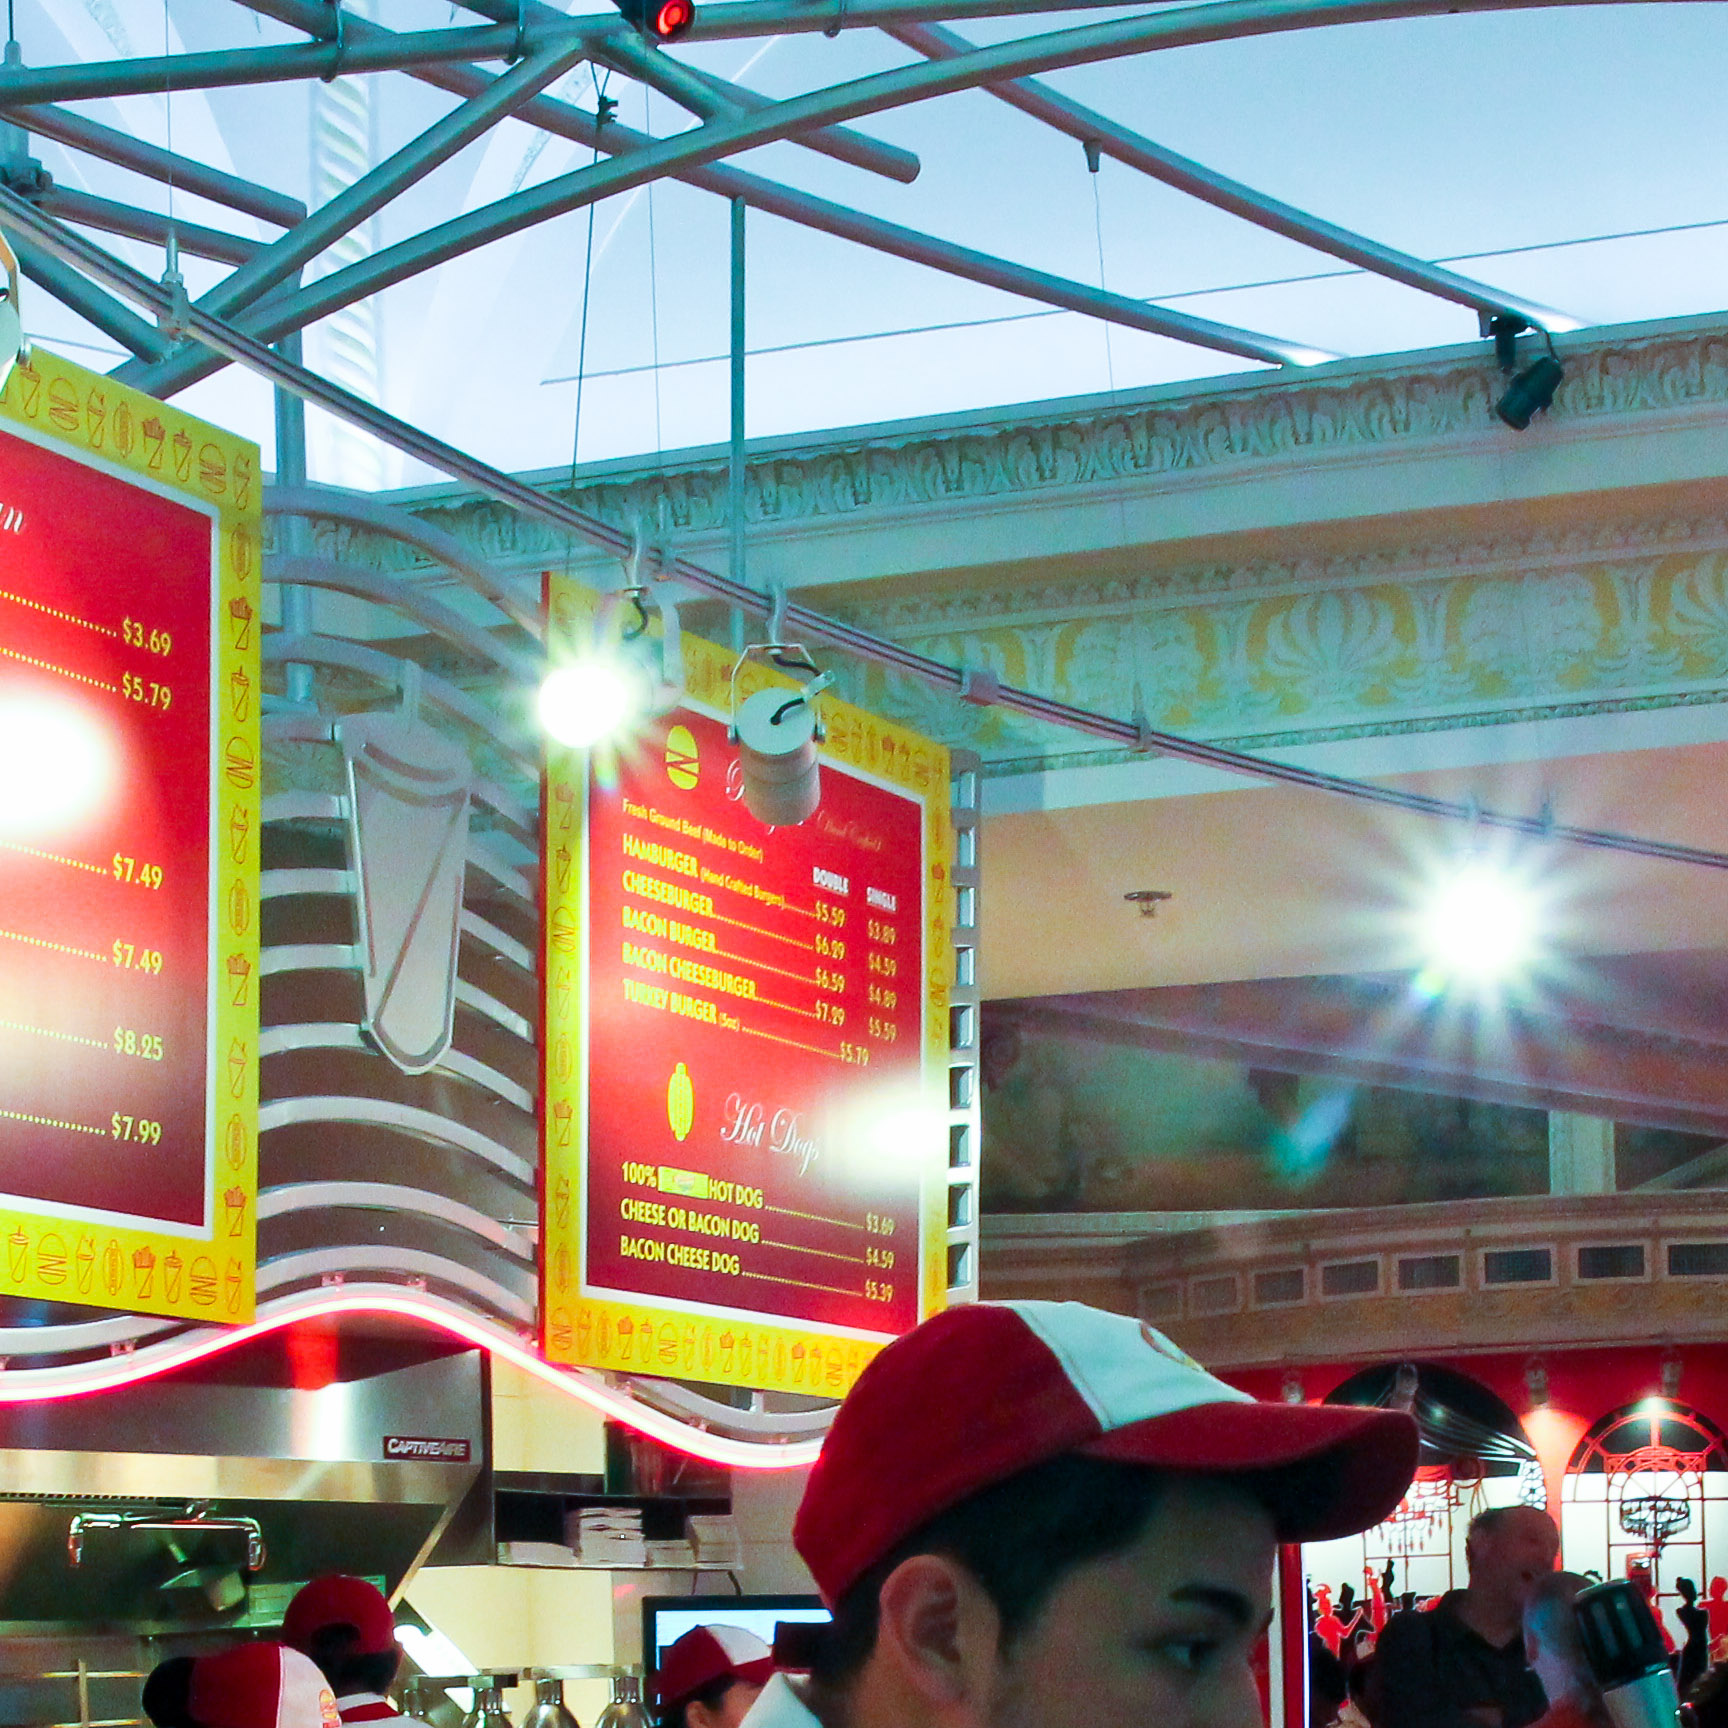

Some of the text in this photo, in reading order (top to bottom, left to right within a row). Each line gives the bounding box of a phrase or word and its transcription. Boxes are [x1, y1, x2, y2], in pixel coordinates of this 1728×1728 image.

[122, 616, 172, 658] $3.69
[122, 670, 172, 711] $5.79
[623, 799, 648, 820] Fresh
[649, 808, 681, 833] Ground
[113, 852, 163, 890] $7.49
[623, 833, 698, 878] HAMBURGER
[622, 870, 713, 916] CHEESEBURGER
[622, 905, 667, 939] BACON
[669, 920, 716, 952] BURGER
[112, 938, 163, 975] $7.49
[622, 942, 667, 973] BACON
[669, 956, 756, 1000] CHEESEBURGER
[622, 979, 668, 1010] TURKEY
[670, 993, 717, 1024] BURGER
[114, 1026, 164, 1062] $8.25
[111, 1112, 161, 1146] $7.99
[720, 1093, 766, 1146] Hot
[622, 1161, 657, 1188] 100%
[709, 1179, 735, 1202] HOT
[736, 1187, 763, 1210] DOG
[621, 1198, 666, 1225] CHEESE
[668, 1208, 686, 1229] OR
[688, 1211, 730, 1238] BACON
[732, 1222, 760, 1244] DOG
[620, 1235, 664, 1262] BACON
[667, 1243, 710, 1270] CHEESE
[712, 1253, 740, 1276] DOG
